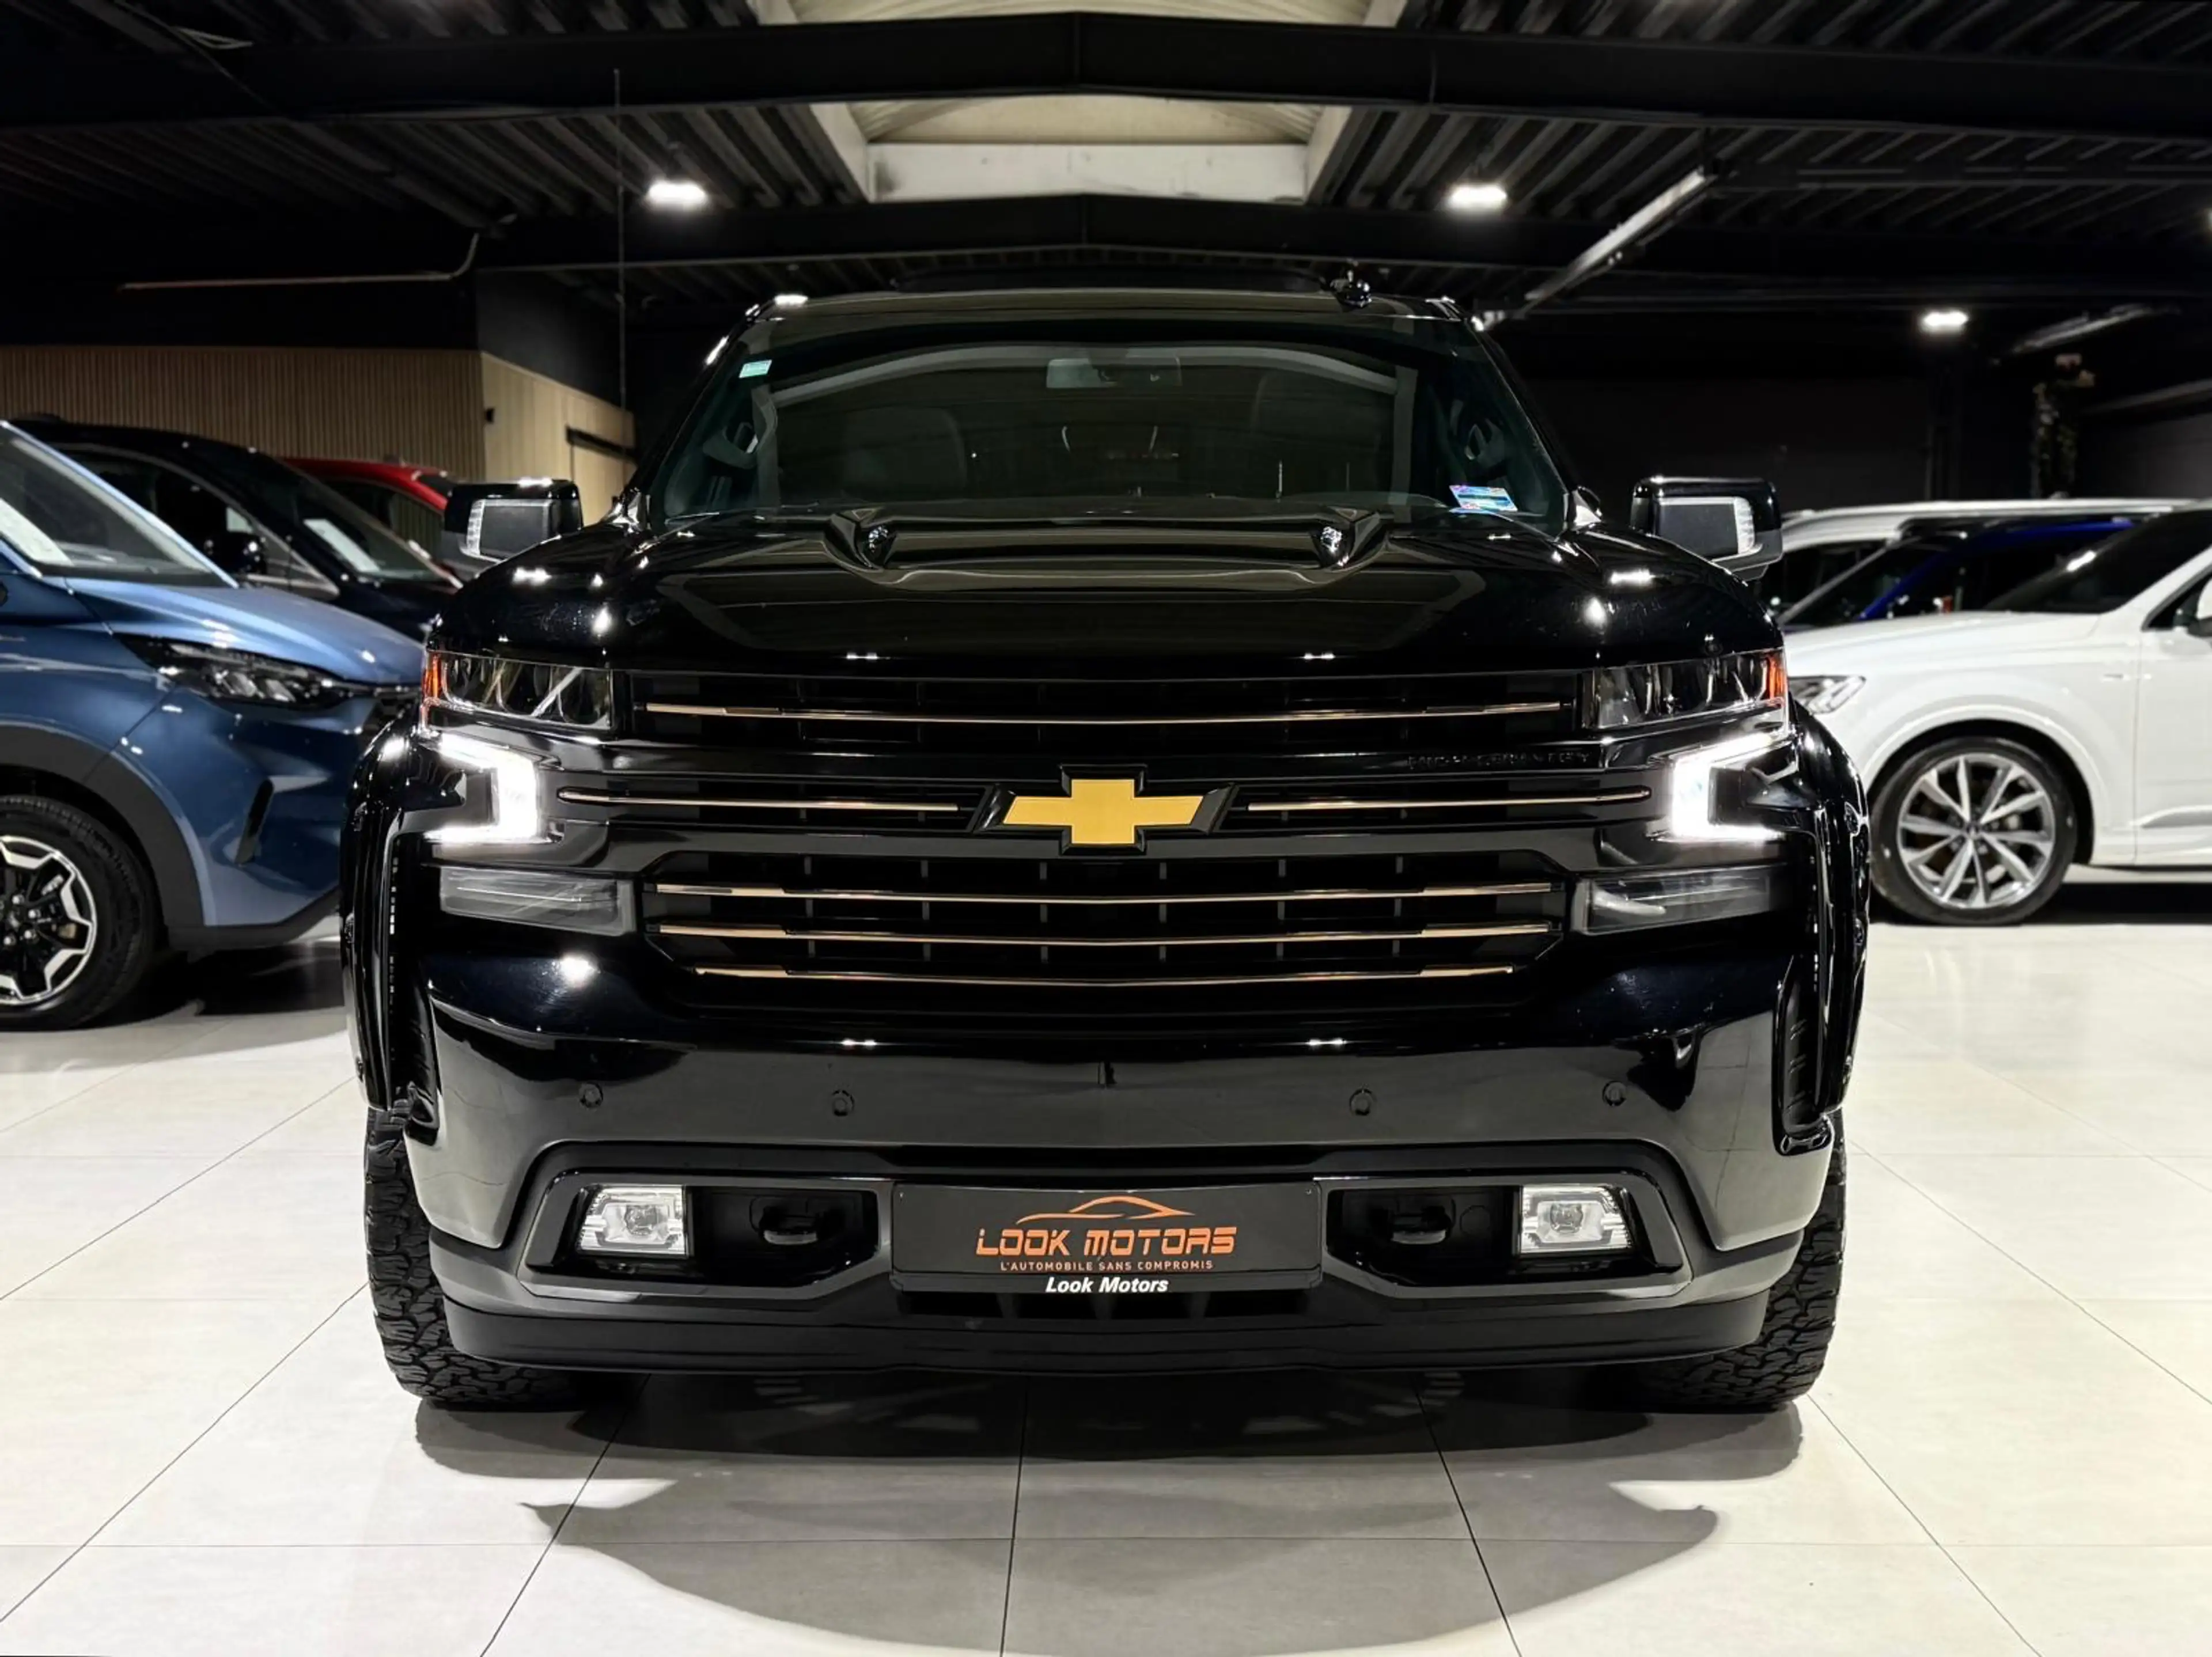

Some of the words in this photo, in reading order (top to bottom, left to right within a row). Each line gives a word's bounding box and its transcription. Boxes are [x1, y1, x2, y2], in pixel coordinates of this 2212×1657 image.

[976, 1228, 1070, 1256] LOOK
[1084, 1226, 1238, 1256] MOTORS
[1000, 1261, 1093, 1271] L'AUTOMOBILE
[1099, 1261, 1132, 1271] SANS
[1137, 1260, 1214, 1271] COMPROMIS
[1045, 1276, 1094, 1293] Look
[1098, 1276, 1169, 1293] Motors
